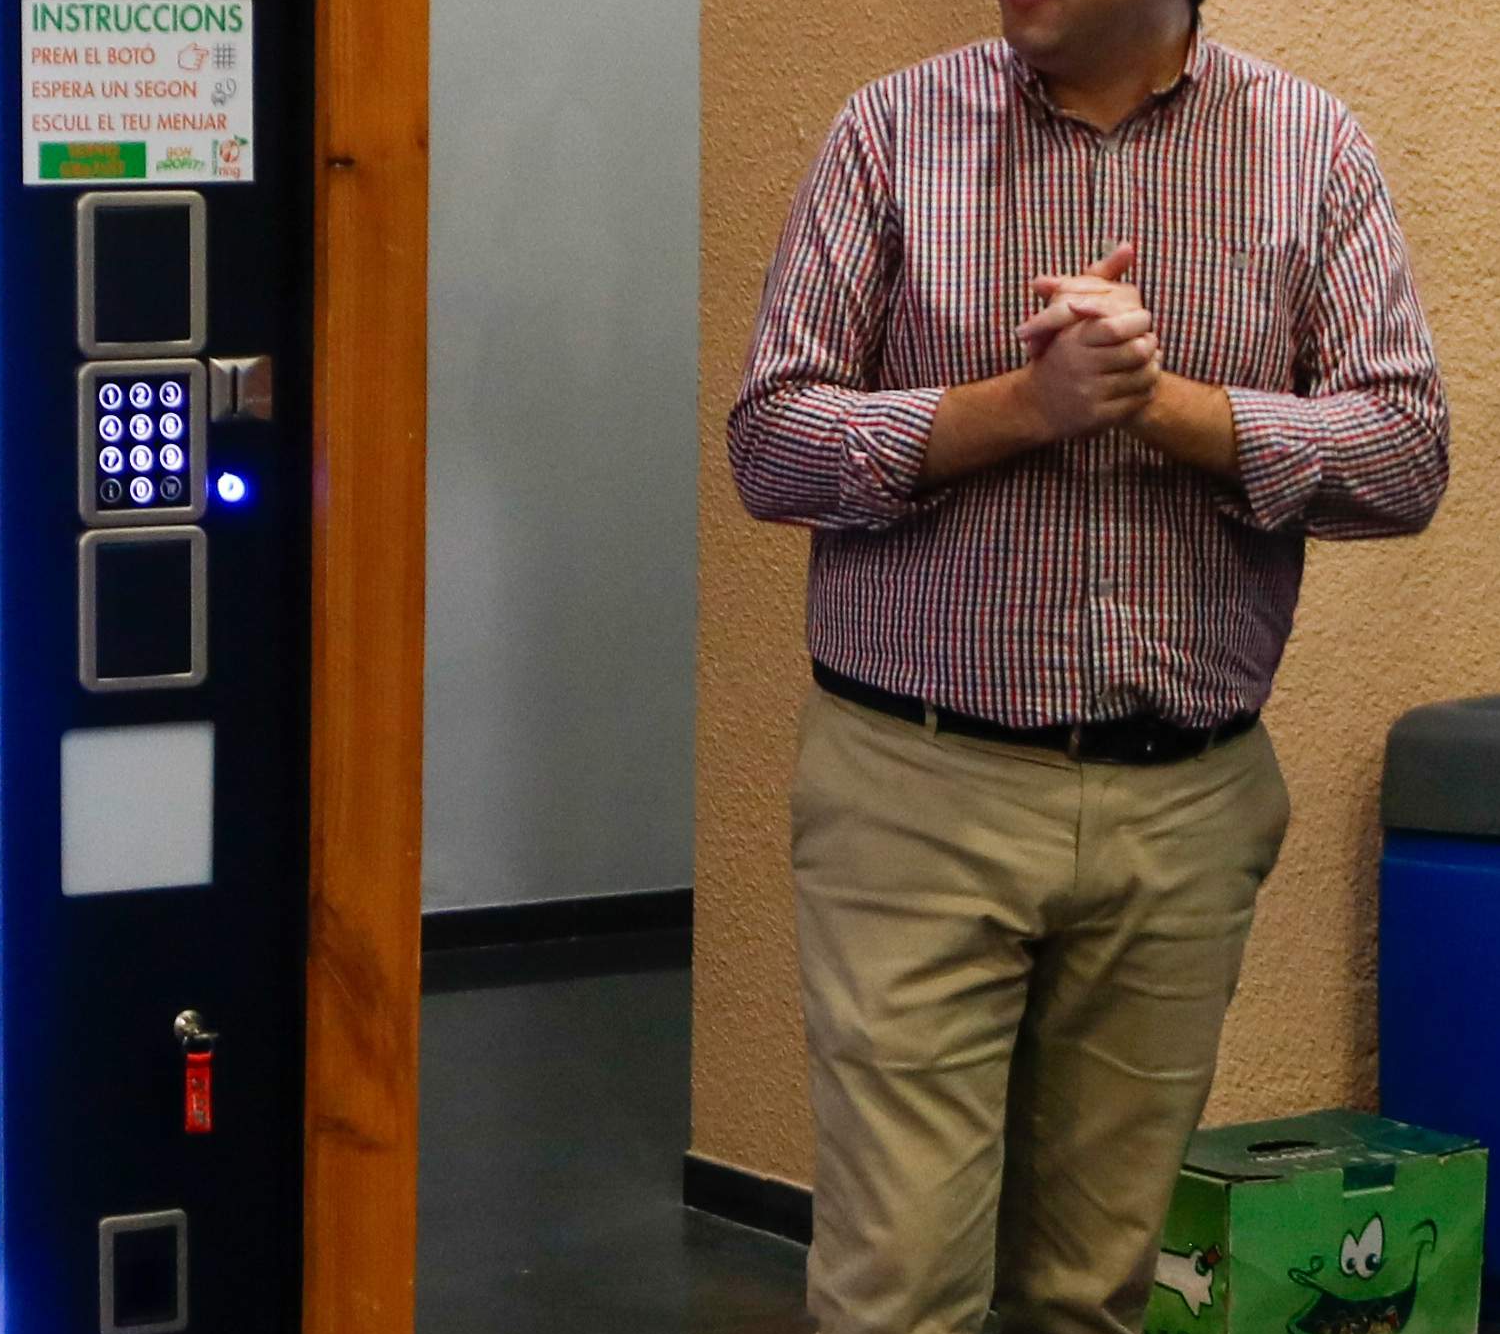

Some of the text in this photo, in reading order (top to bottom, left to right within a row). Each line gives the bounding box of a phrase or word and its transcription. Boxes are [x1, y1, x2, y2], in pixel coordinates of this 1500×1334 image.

[32, 2, 244, 33] INSTRUCCIONS
[32, 46, 78, 65] PREM
[85, 47, 100, 65] EL
[32, 80, 197, 98] ESPERA UN SEGON
[32, 113, 228, 132] ESCULL EL TEU MENJAR
